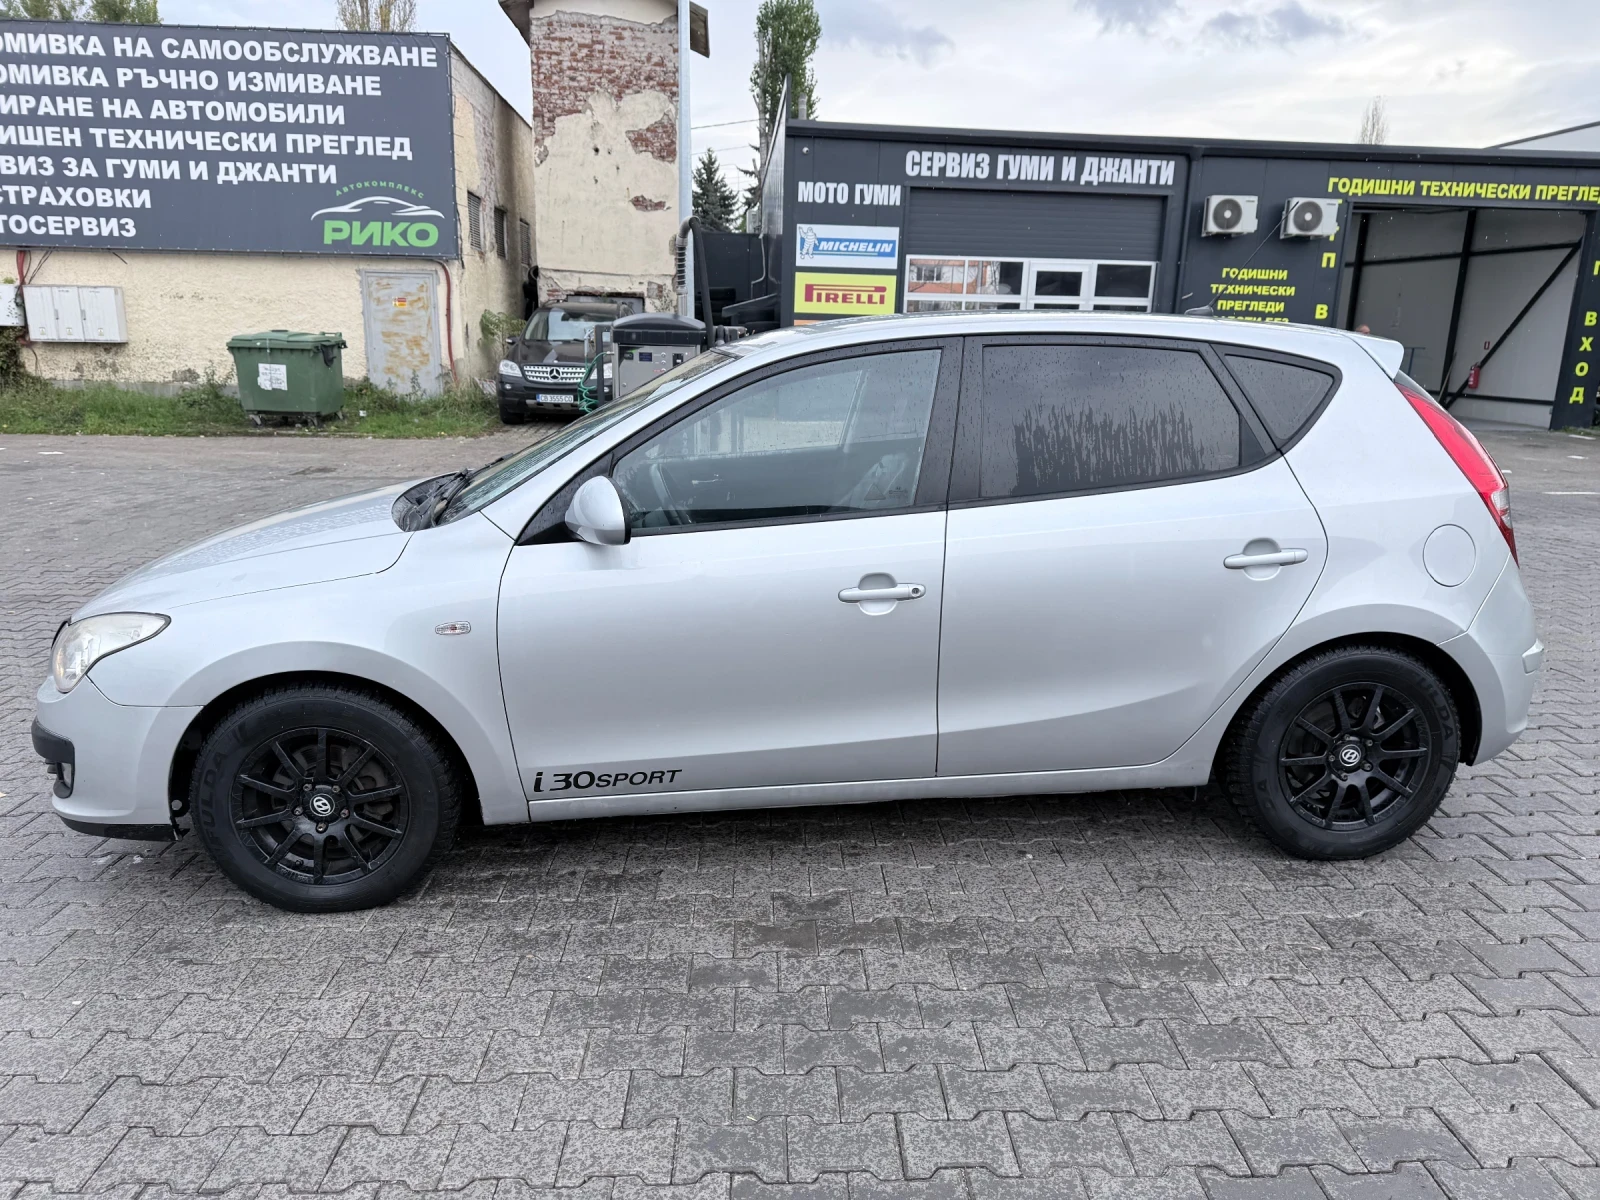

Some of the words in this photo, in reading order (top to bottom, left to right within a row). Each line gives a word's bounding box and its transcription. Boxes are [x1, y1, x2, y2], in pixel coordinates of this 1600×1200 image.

[0, 32, 106, 56] МИВКА
[112, 36, 155, 58] НА
[161, 37, 438, 68] САМООБСЛУЖВАНЕ
[116, 67, 219, 91] РЪЧНО
[227, 71, 382, 96] ИЗМИВАНЕ
[101, 97, 143, 119] НА
[149, 99, 345, 125] АВТОМОБИЛИ
[89, 127, 277, 153] ТЕХНИЧЕСКИ
[285, 133, 413, 161] ПРЕГЛЕД
[61, 156, 99, 178] ЗА
[105, 158, 181, 180] ГУМИ
[188, 160, 209, 181] И
[216, 161, 337, 185] ДЖАНТИ
[905, 149, 990, 179] СЕРВИЗ
[996, 153, 1055, 181] ГУМИ
[1060, 156, 1077, 181] И
[1079, 156, 1175, 186] ДЖАНТИ
[0, 185, 151, 208] ТРАХОВКИ
[335, 180, 424, 199] АВТОКОМПЛЕКС
[797, 181, 849, 205] МОТО
[854, 183, 901, 206] ГУМИ
[1327, 177, 1416, 196] ГОДИШНИ
[1420, 180, 1532, 200] ТЕХНИЧЕСКИ
[1534, 184, 1600, 204] ПРЕГЛЕ
[323, 219, 439, 248] РИКО
[818, 240, 894, 254] MICHELIN
[1221, 268, 1288, 280] ГОДИШНИ
[804, 283, 887, 305] PIRELLI
[1210, 283, 1296, 297] ТЕХНИЧЕСКИ
[1217, 299, 1285, 314] ПРЕГЛЕДИ
